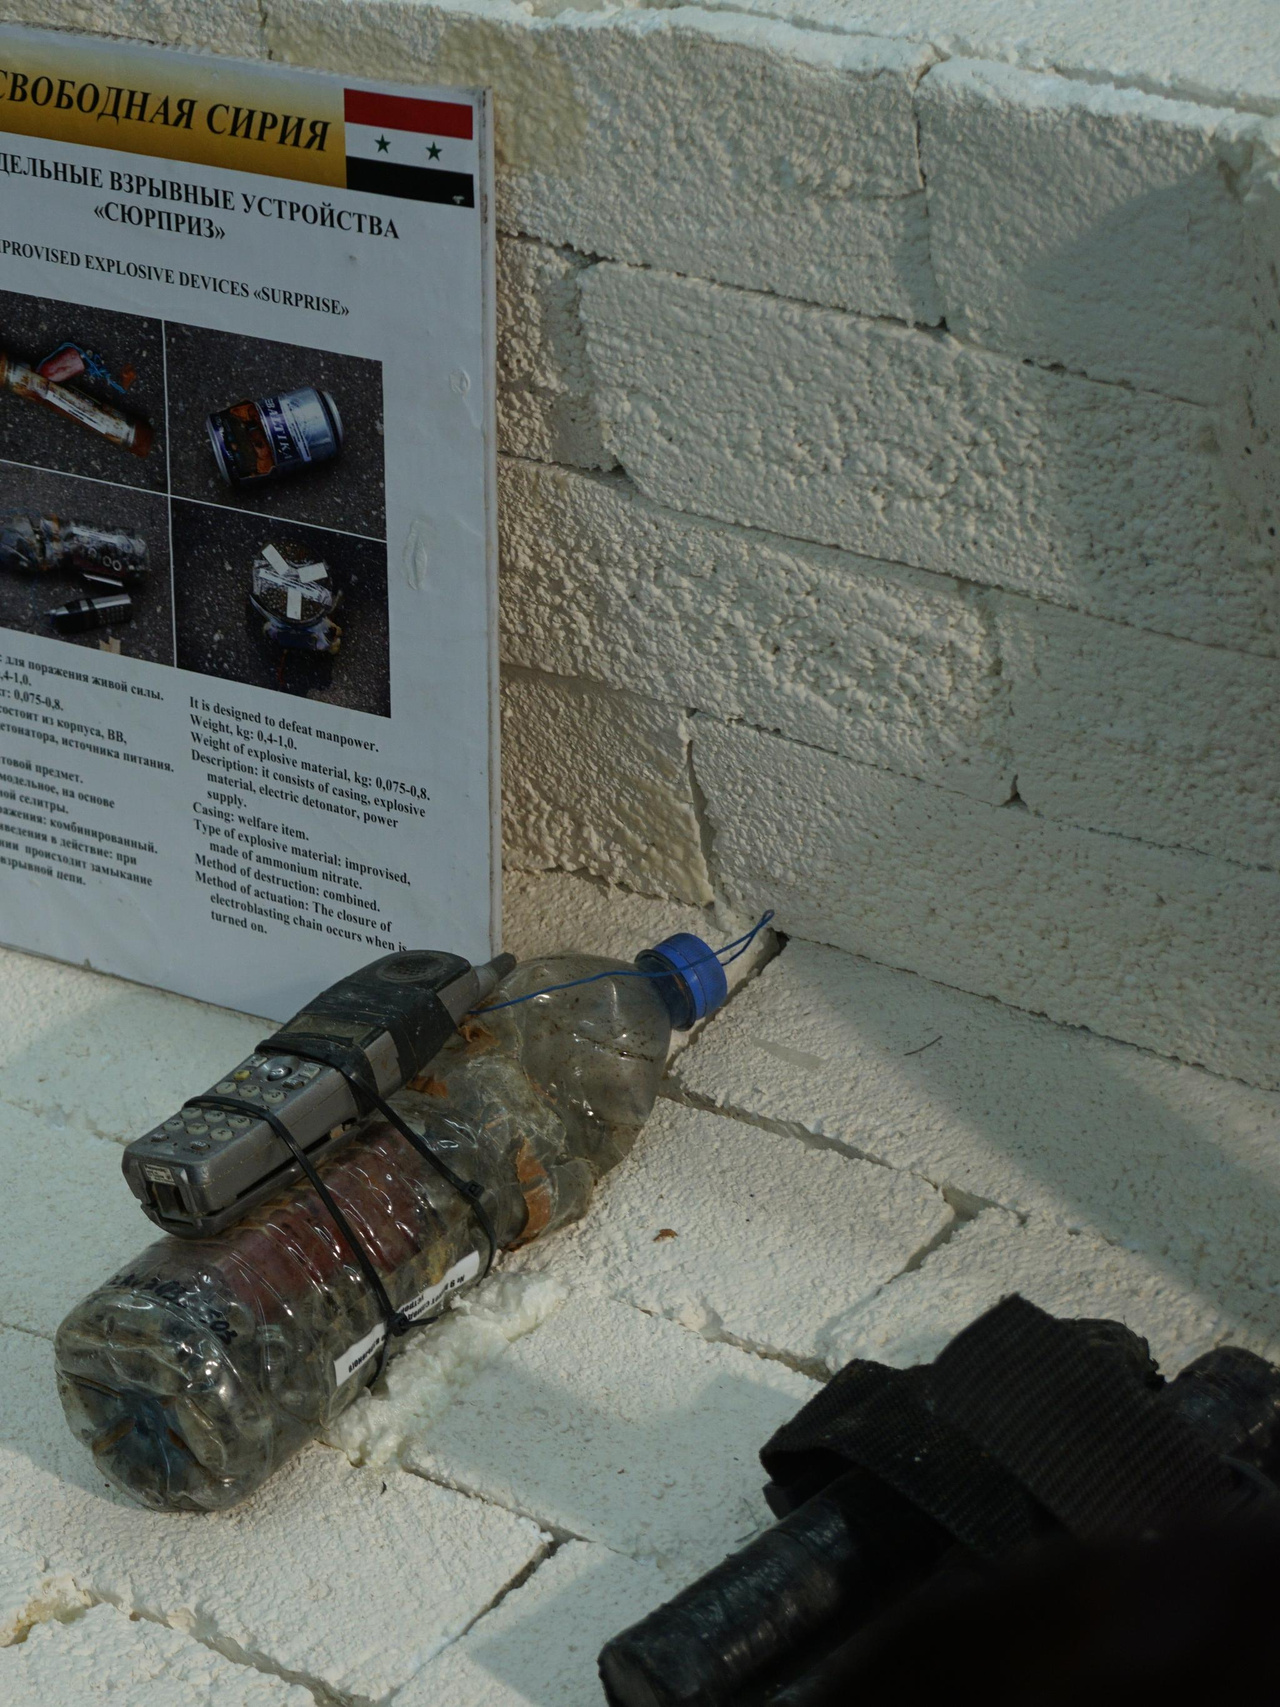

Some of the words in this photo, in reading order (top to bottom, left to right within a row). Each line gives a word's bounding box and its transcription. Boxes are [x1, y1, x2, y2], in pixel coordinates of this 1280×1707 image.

[206, 103, 331, 152] СИРИЯ
[93, 202, 225, 239] «СЮРПРИЗ»
[109, 170, 234, 210] ВЗРЫВНЫЕ
[240, 192, 399, 239] УСТРОЙСТВА
[84, 254, 174, 284] EXPLOSIVE
[178, 270, 249, 297] DEVICES
[253, 286, 349, 316] «SURPRISE»
[4, 655, 25, 667] для
[27, 660, 88, 683] поражения
[91, 676, 127, 692] живой
[130, 685, 163, 700] силы.
[13, 688, 63, 711] 0,075-0,8.
[41, 715, 54, 725] из
[56, 718, 104, 739] корпуса,
[107, 728, 127, 745] ВВ,
[189, 695, 198, 709] It
[201, 698, 210, 711] is
[212, 702, 261, 723] designed
[264, 715, 275, 726] to
[278, 717, 312, 736] defeat
[315, 729, 378, 752] manpower.
[189, 713, 233, 735] Weight,
[236, 724, 253, 741] kg:
[256, 729, 297, 750] 0,4-1,0.
[34, 764, 83, 783] предмет.
[61, 736, 119, 759] источника
[122, 752, 174, 772] питания.
[190, 730, 230, 751] Weight
[233, 743, 245, 754] of
[247, 748, 297, 767] explosive
[300, 760, 350, 782] material,
[354, 770, 371, 788] kg:
[375, 776, 430, 800] 0,075-0,8.
[61, 787, 75, 798] на
[77, 792, 115, 808] основе
[191, 748, 258, 775] Description:
[261, 765, 269, 778] it
[272, 771, 314, 790] consists
[317, 781, 330, 793] of
[331, 786, 370, 806] casing,
[373, 796, 425, 817] explosive
[206, 790, 246, 809] supply.
[207, 772, 256, 794] material,
[258, 784, 299, 803] electric
[301, 794, 360, 820] detonator,
[363, 811, 398, 828] power
[18, 794, 68, 814] селитры.
[192, 801, 234, 823] Casing:
[237, 814, 278, 832] welfare
[281, 823, 308, 840] item.
[49, 818, 157, 854] комбинированный.
[50, 835, 57, 844] в
[59, 838, 112, 858] действие:
[116, 852, 136, 866] при
[193, 818, 220, 836] Type
[223, 827, 236, 839] of
[237, 832, 287, 852] explosive
[290, 846, 341, 866] material:
[344, 856, 410, 886] improvised,
[24, 845, 86, 869] происходит
[90, 862, 152, 886] замыкание
[56, 870, 86, 885] цепи.
[195, 852, 236, 874] Method
[239, 866, 251, 877] of
[253, 868, 319, 896] destruction:
[322, 889, 380, 912] combined.
[209, 842, 238, 857] made
[241, 849, 253, 861] of
[255, 854, 318, 878] ammonium
[321, 870, 362, 889] nitrate.
[195, 870, 236, 891] Method
[239, 883, 251, 895] of
[253, 888, 308, 910] actuation:
[312, 900, 333, 917] The
[336, 908, 376, 928] closure
[379, 920, 392, 932] of
[210, 892, 290, 925] electroblasting
[292, 914, 322, 931] chain
[325, 925, 362, 941] occurs
[364, 935, 394, 950] when
[210, 910, 247, 928] turned
[250, 922, 267, 934] on.
